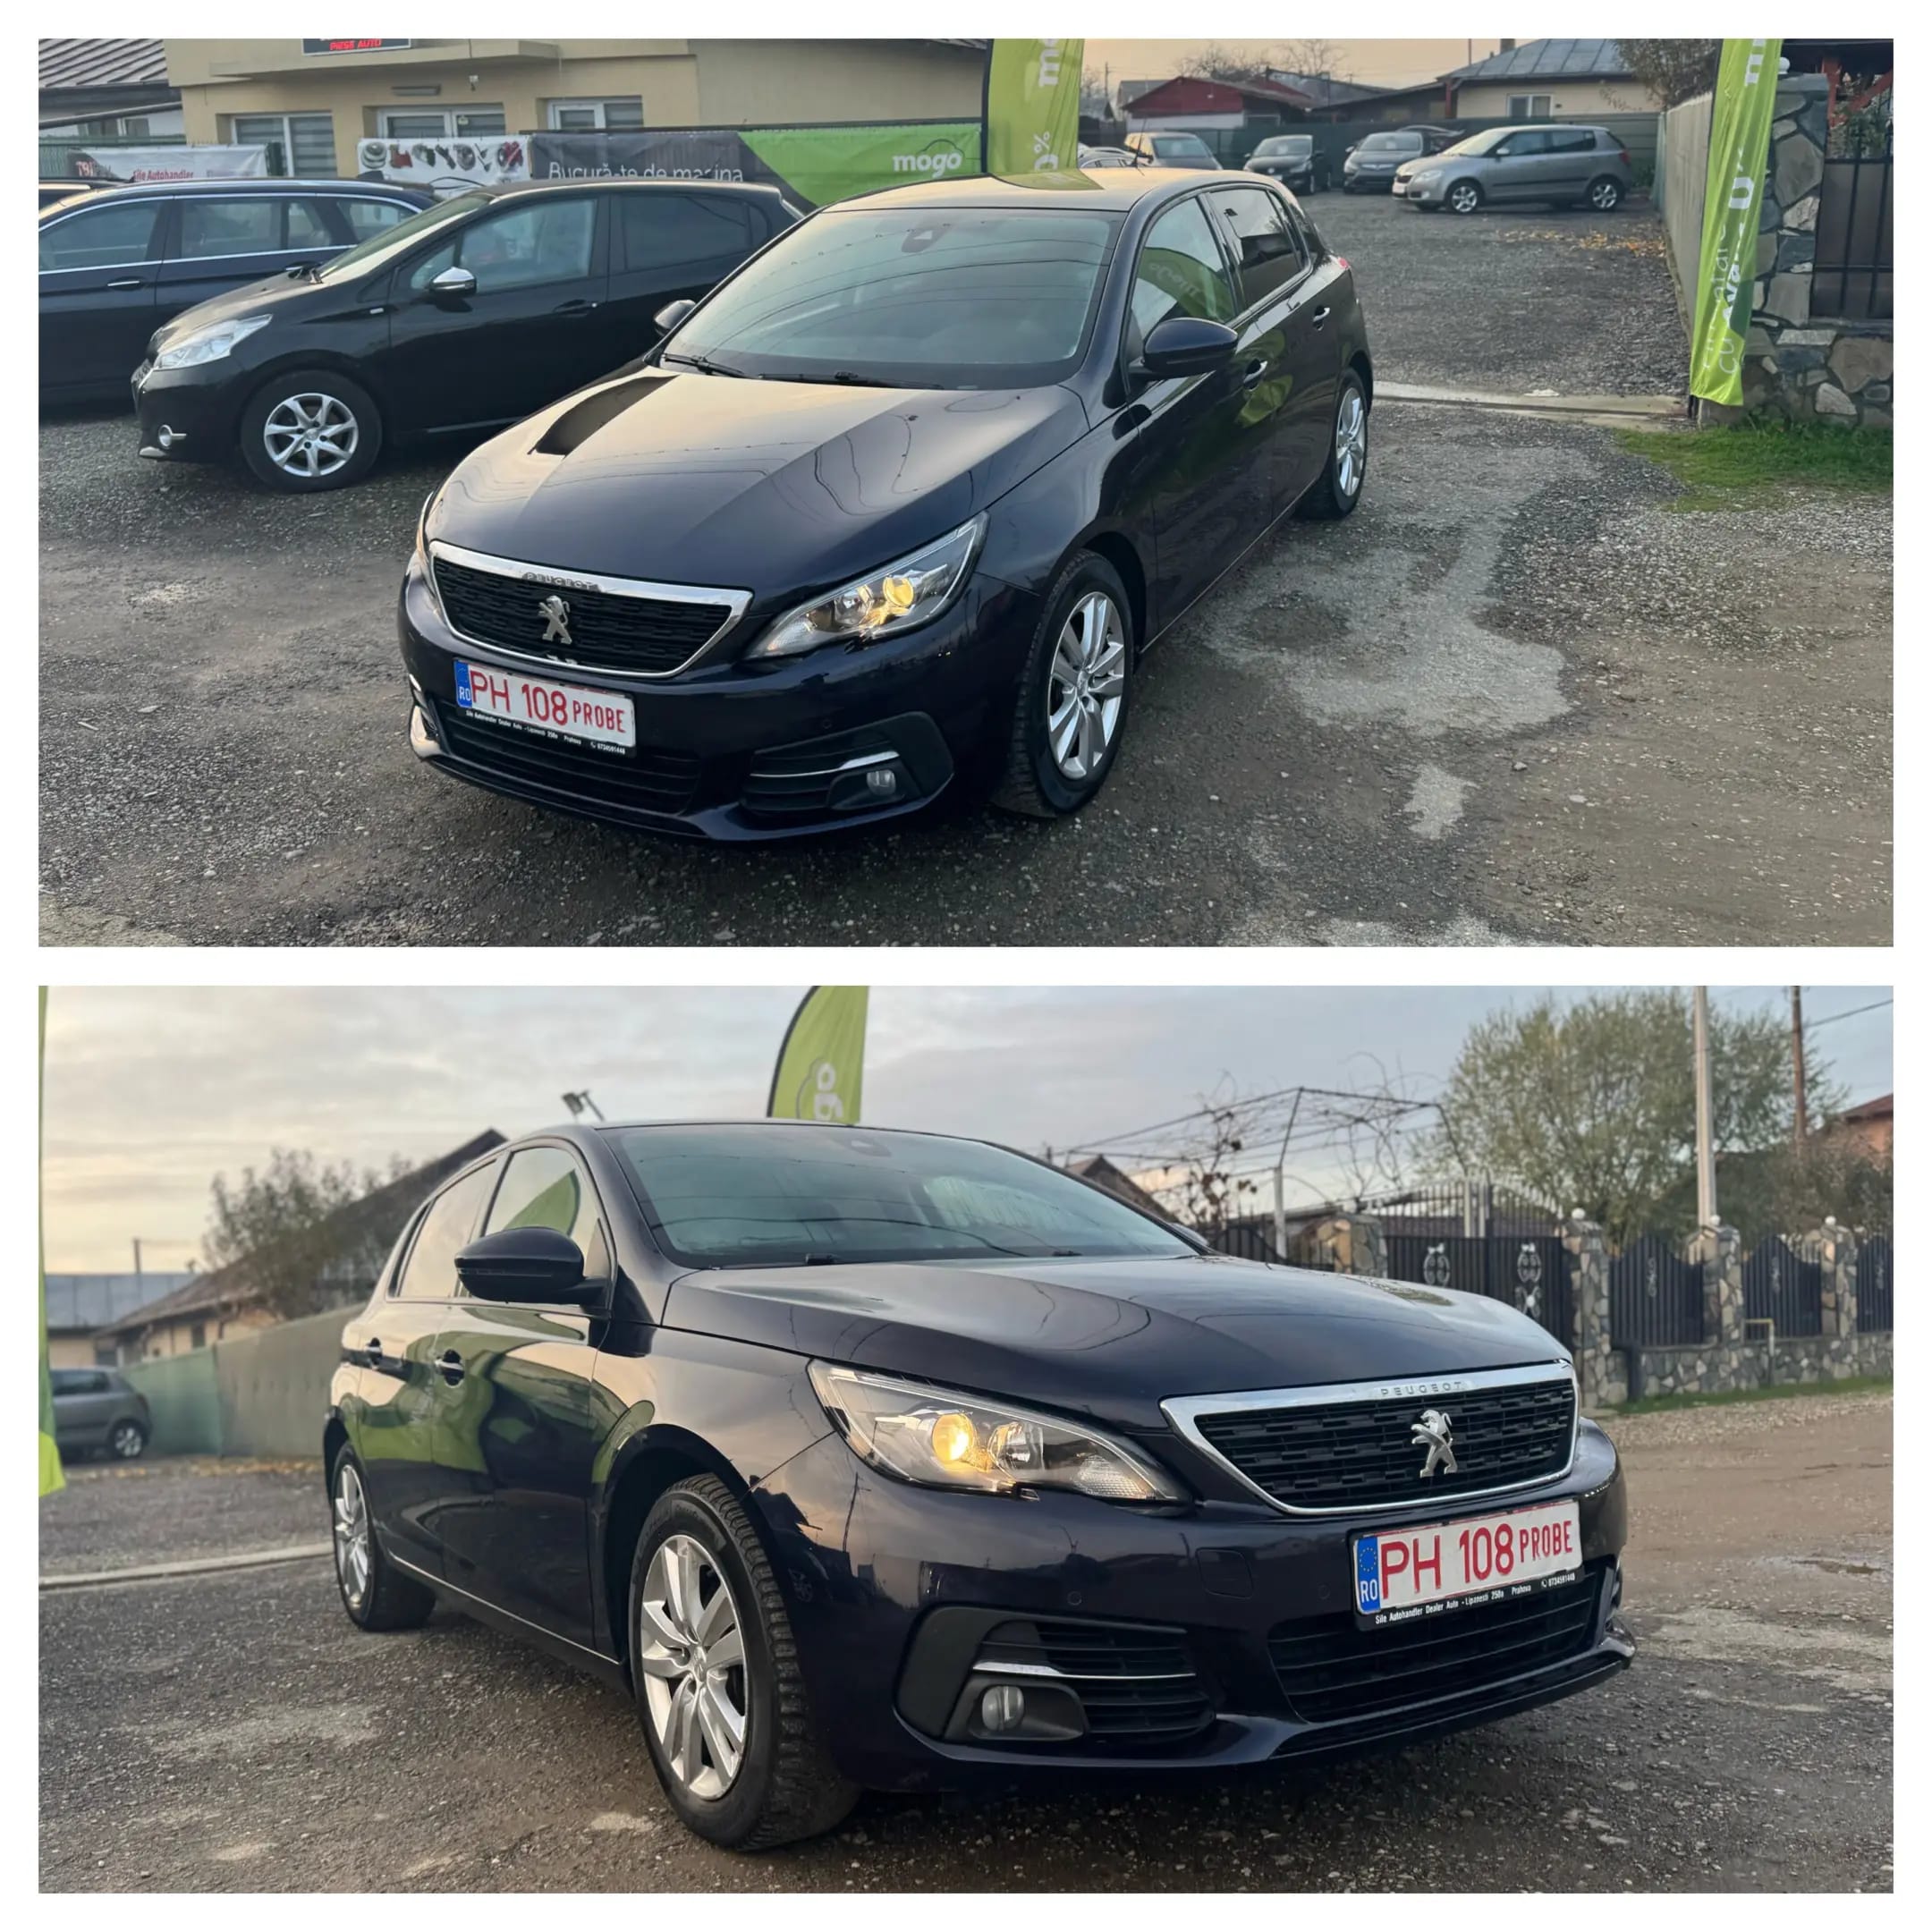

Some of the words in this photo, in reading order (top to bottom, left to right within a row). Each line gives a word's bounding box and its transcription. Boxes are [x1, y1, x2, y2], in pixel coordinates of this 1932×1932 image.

[358, 38, 382, 48] AUTO
[643, 163, 667, 178] de
[893, 152, 962, 179] mogo
[527, 572, 593, 590] PEUGEOT
[459, 687, 471, 701] RO
[470, 670, 511, 714] PH
[521, 683, 568, 726] 108
[572, 700, 626, 733] PROBE
[1381, 1381, 1462, 1397] PEUGEOT
[1381, 1535, 1442, 1600] PH
[1459, 1523, 1515, 1584] 108
[1520, 1521, 1573, 1563] PROBE
[1360, 1579, 1378, 1603] RO
[1389, 1607, 1423, 1622] Autohandler
[1425, 1602, 1444, 1614] Dealer
[1446, 1599, 1459, 1609] Auto
[1512, 1584, 1531, 1596] Prahova
